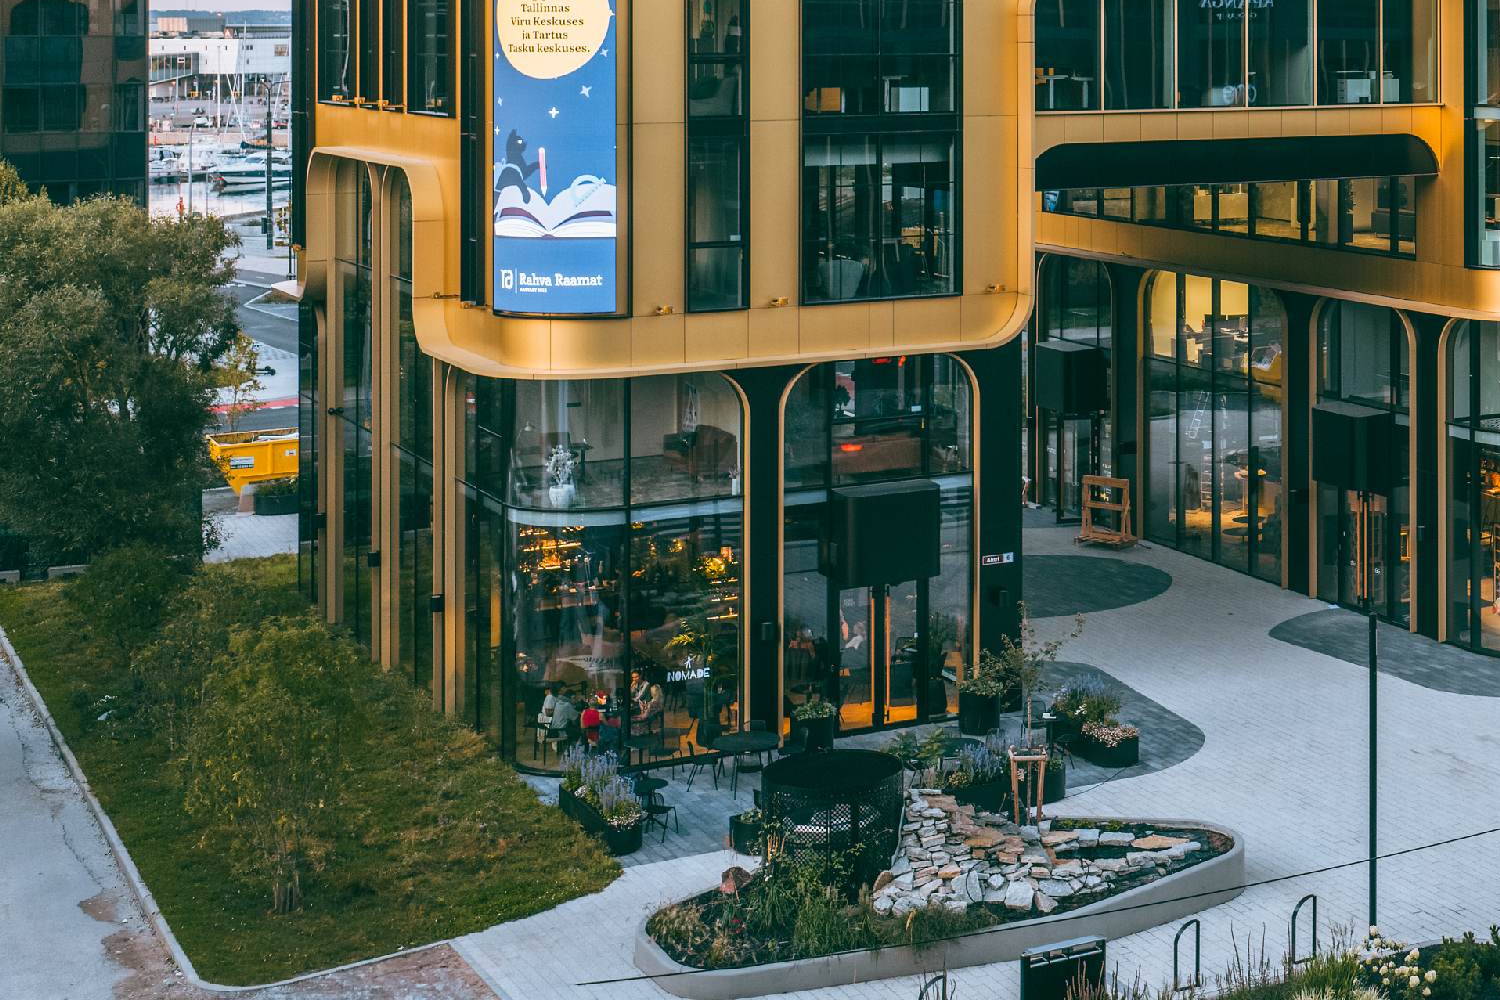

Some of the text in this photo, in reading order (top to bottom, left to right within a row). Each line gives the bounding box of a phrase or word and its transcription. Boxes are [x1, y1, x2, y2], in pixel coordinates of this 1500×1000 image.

[521, 3, 570, 13] Tallinnas
[510, 16, 584, 26] Viru Keskuses
[522, 30, 568, 40] ja Tartus
[508, 43, 591, 53] Tasku keskuses.
[519, 273, 552, 286] Rahva
[554, 273, 603, 286] Raamat
[667, 667, 710, 682] NOMADE
